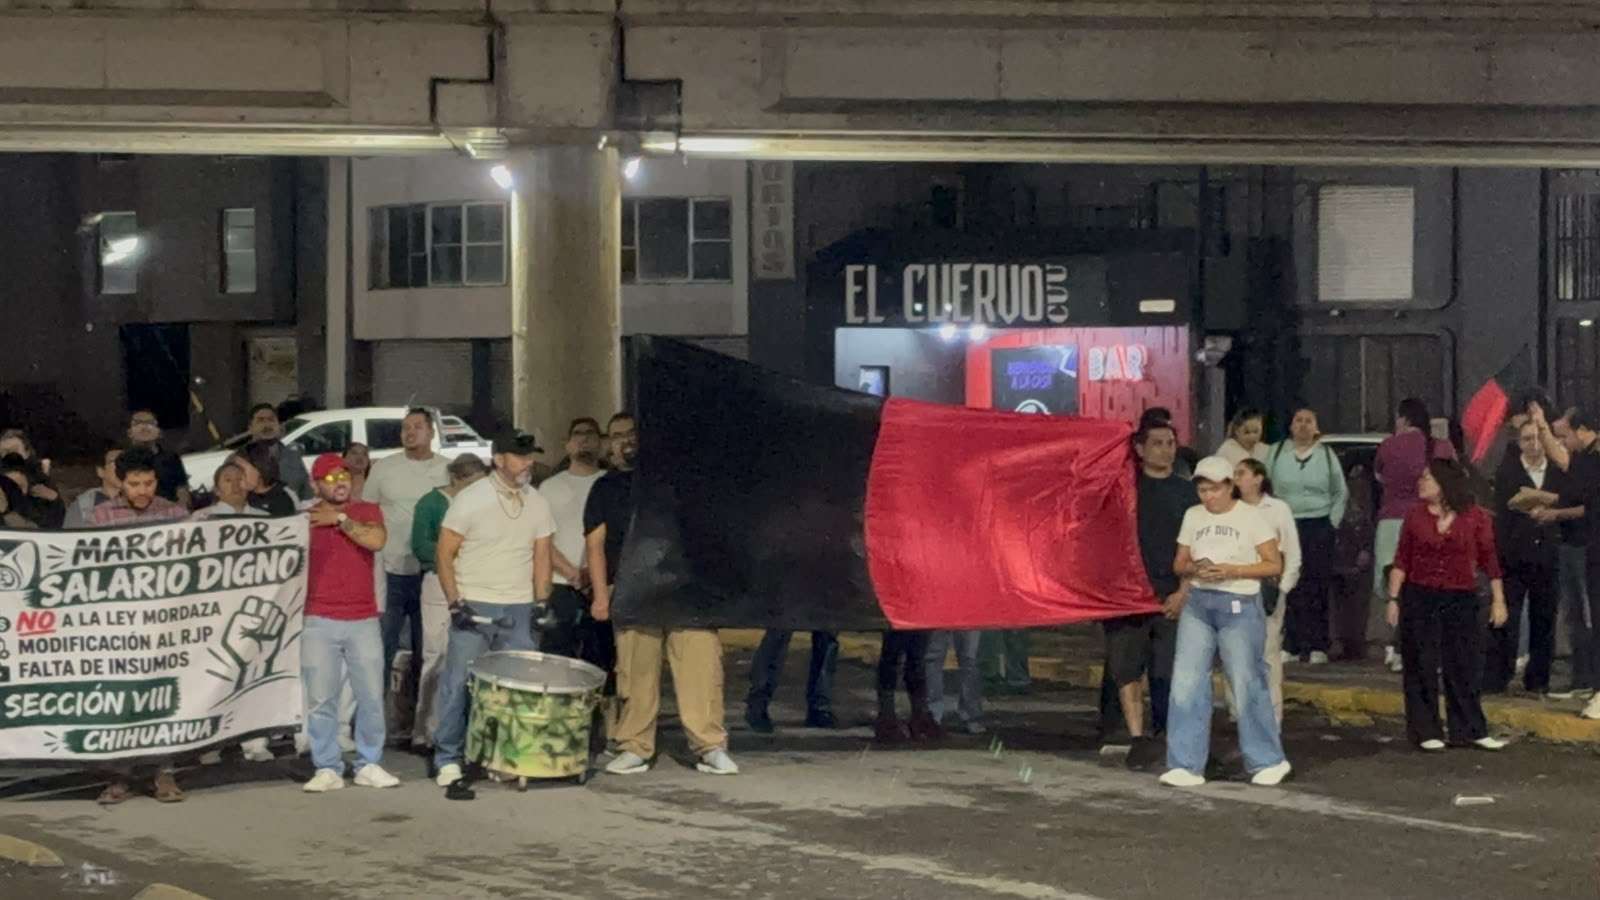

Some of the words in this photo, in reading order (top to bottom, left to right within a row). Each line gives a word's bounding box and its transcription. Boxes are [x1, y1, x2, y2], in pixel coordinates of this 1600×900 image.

[845, 264, 885, 324] EL
[903, 263, 1043, 325] CUERVO
[1087, 345, 1147, 382] BAR
[72, 525, 206, 566] MARCHA
[218, 521, 270, 549] POR
[1214, 524, 1241, 541] DUTY
[39, 563, 191, 607] SALARIO
[198, 549, 301, 591] DIGNO
[16, 611, 56, 632] NO
[62, 614, 74, 627] A
[79, 612, 98, 626] LA
[106, 610, 138, 625] LEY
[142, 601, 222, 625] MORDAZA
[18, 632, 151, 655] MODIFICACIÓN
[157, 632, 176, 650] AL
[181, 626, 213, 646] RJP
[19, 659, 75, 678] FALTA
[80, 660, 103, 675] DE
[108, 651, 190, 675] INSUMOS
[5, 684, 125, 718] SECCIÓN
[131, 685, 173, 713] VIII
[83, 718, 213, 751] CHIHUAHUA
